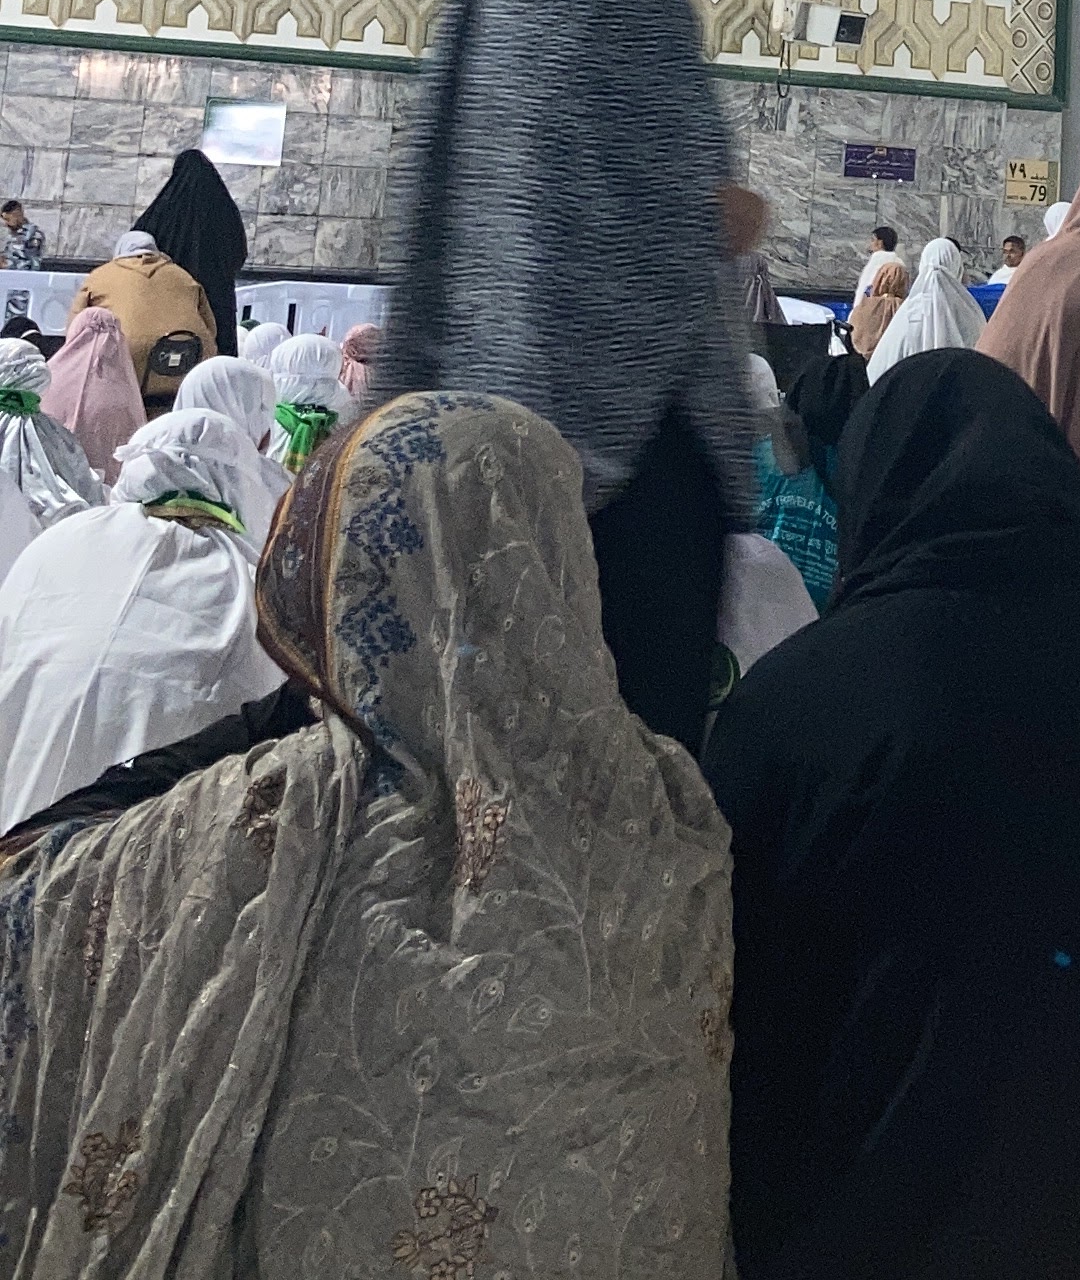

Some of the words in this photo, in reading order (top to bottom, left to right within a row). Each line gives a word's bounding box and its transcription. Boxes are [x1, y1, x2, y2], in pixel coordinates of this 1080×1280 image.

[1009, 161, 1026, 179] ٧٩
[1029, 185, 1047, 202] 79
[822, 509, 838, 531] TOU
